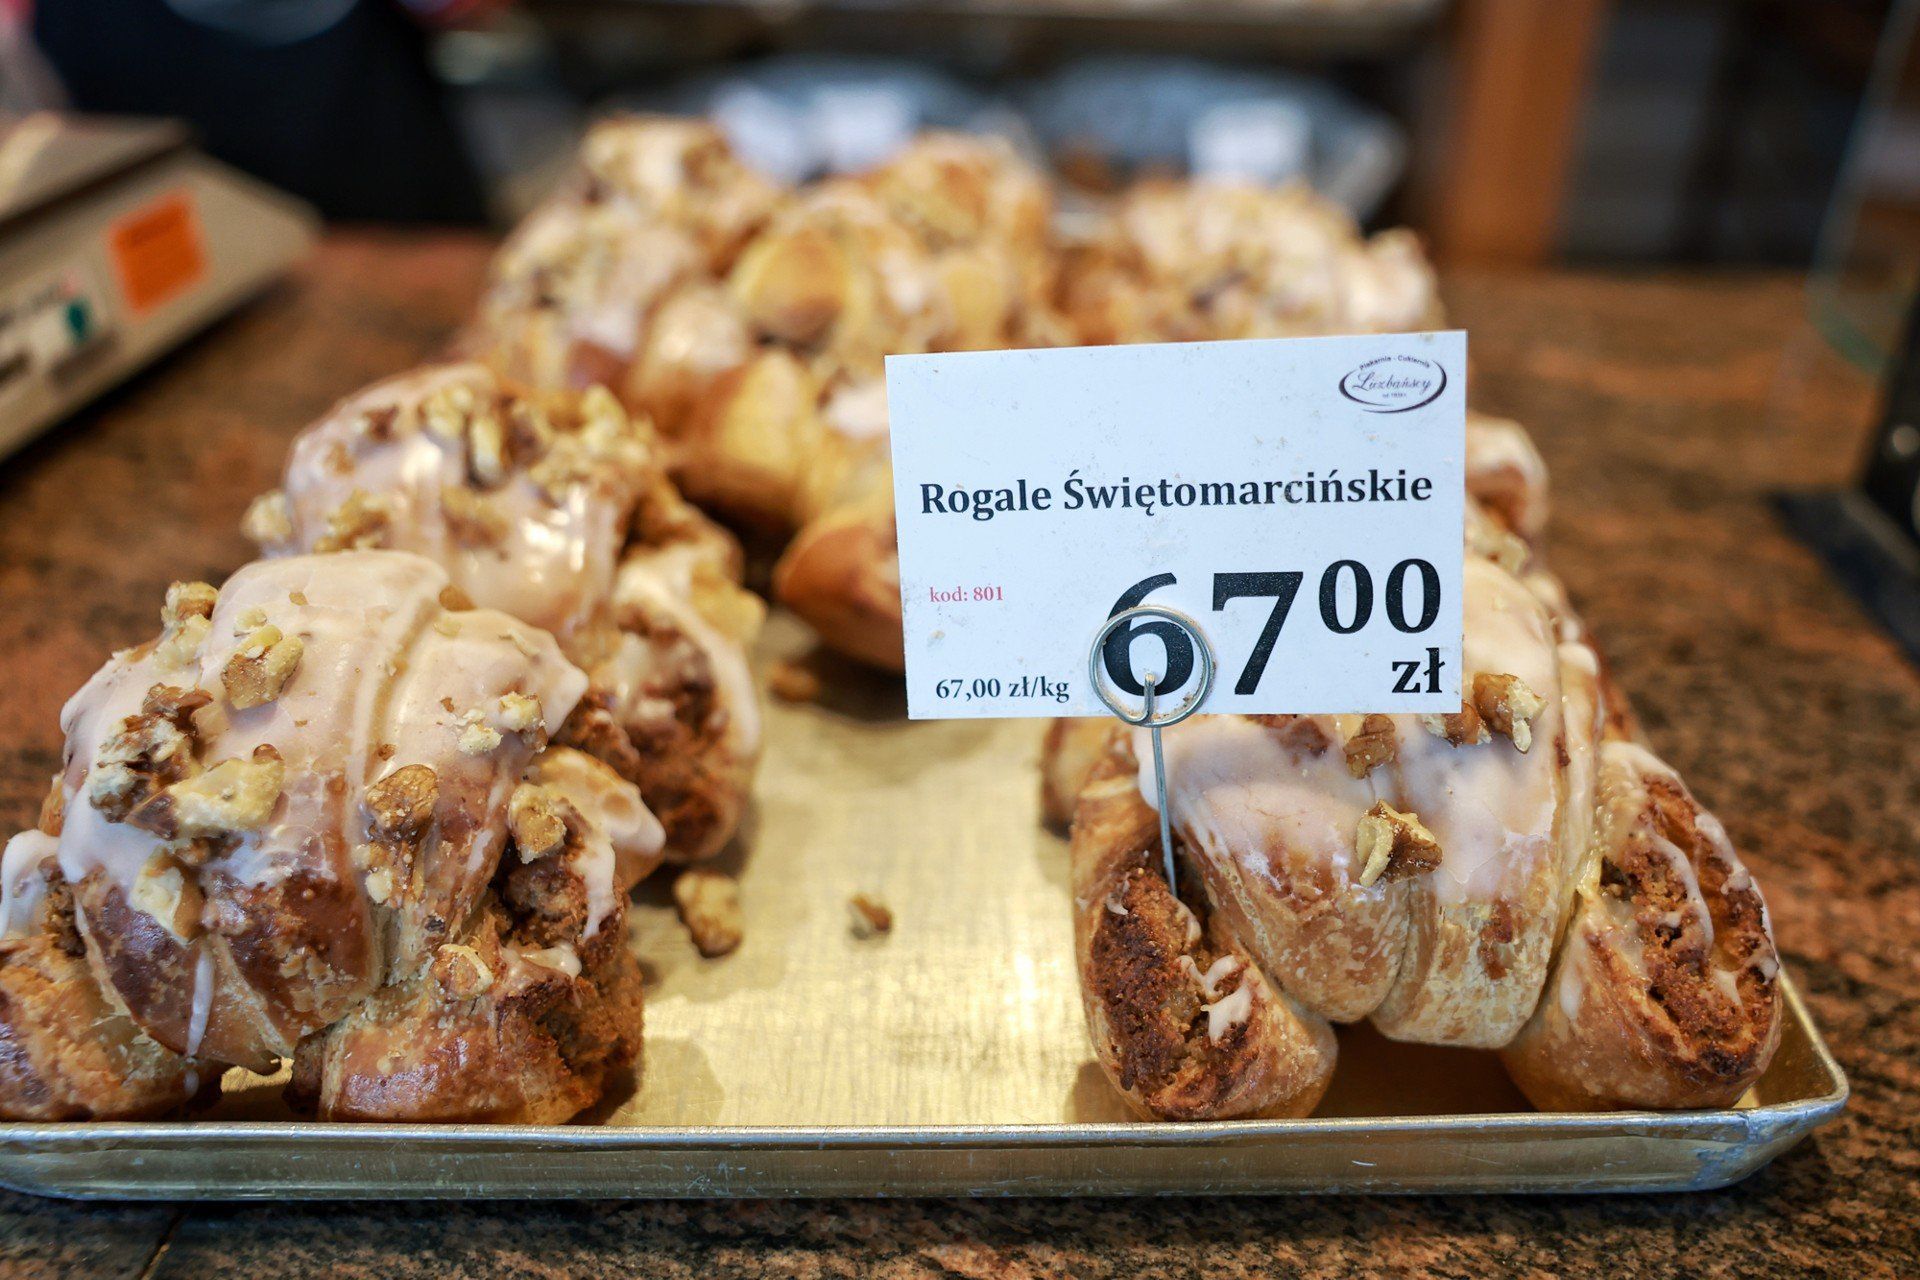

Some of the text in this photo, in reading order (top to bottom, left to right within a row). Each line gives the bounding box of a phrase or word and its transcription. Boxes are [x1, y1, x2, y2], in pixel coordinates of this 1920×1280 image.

[1359, 355, 1392, 370] Piekarnia
[920, 468, 1433, 521] Rogale Świętomarcińskie
[929, 585, 1003, 603] kod: 801
[1391, 647, 1446, 694] zł
[935, 675, 1070, 704] 67,00 zł/kg
